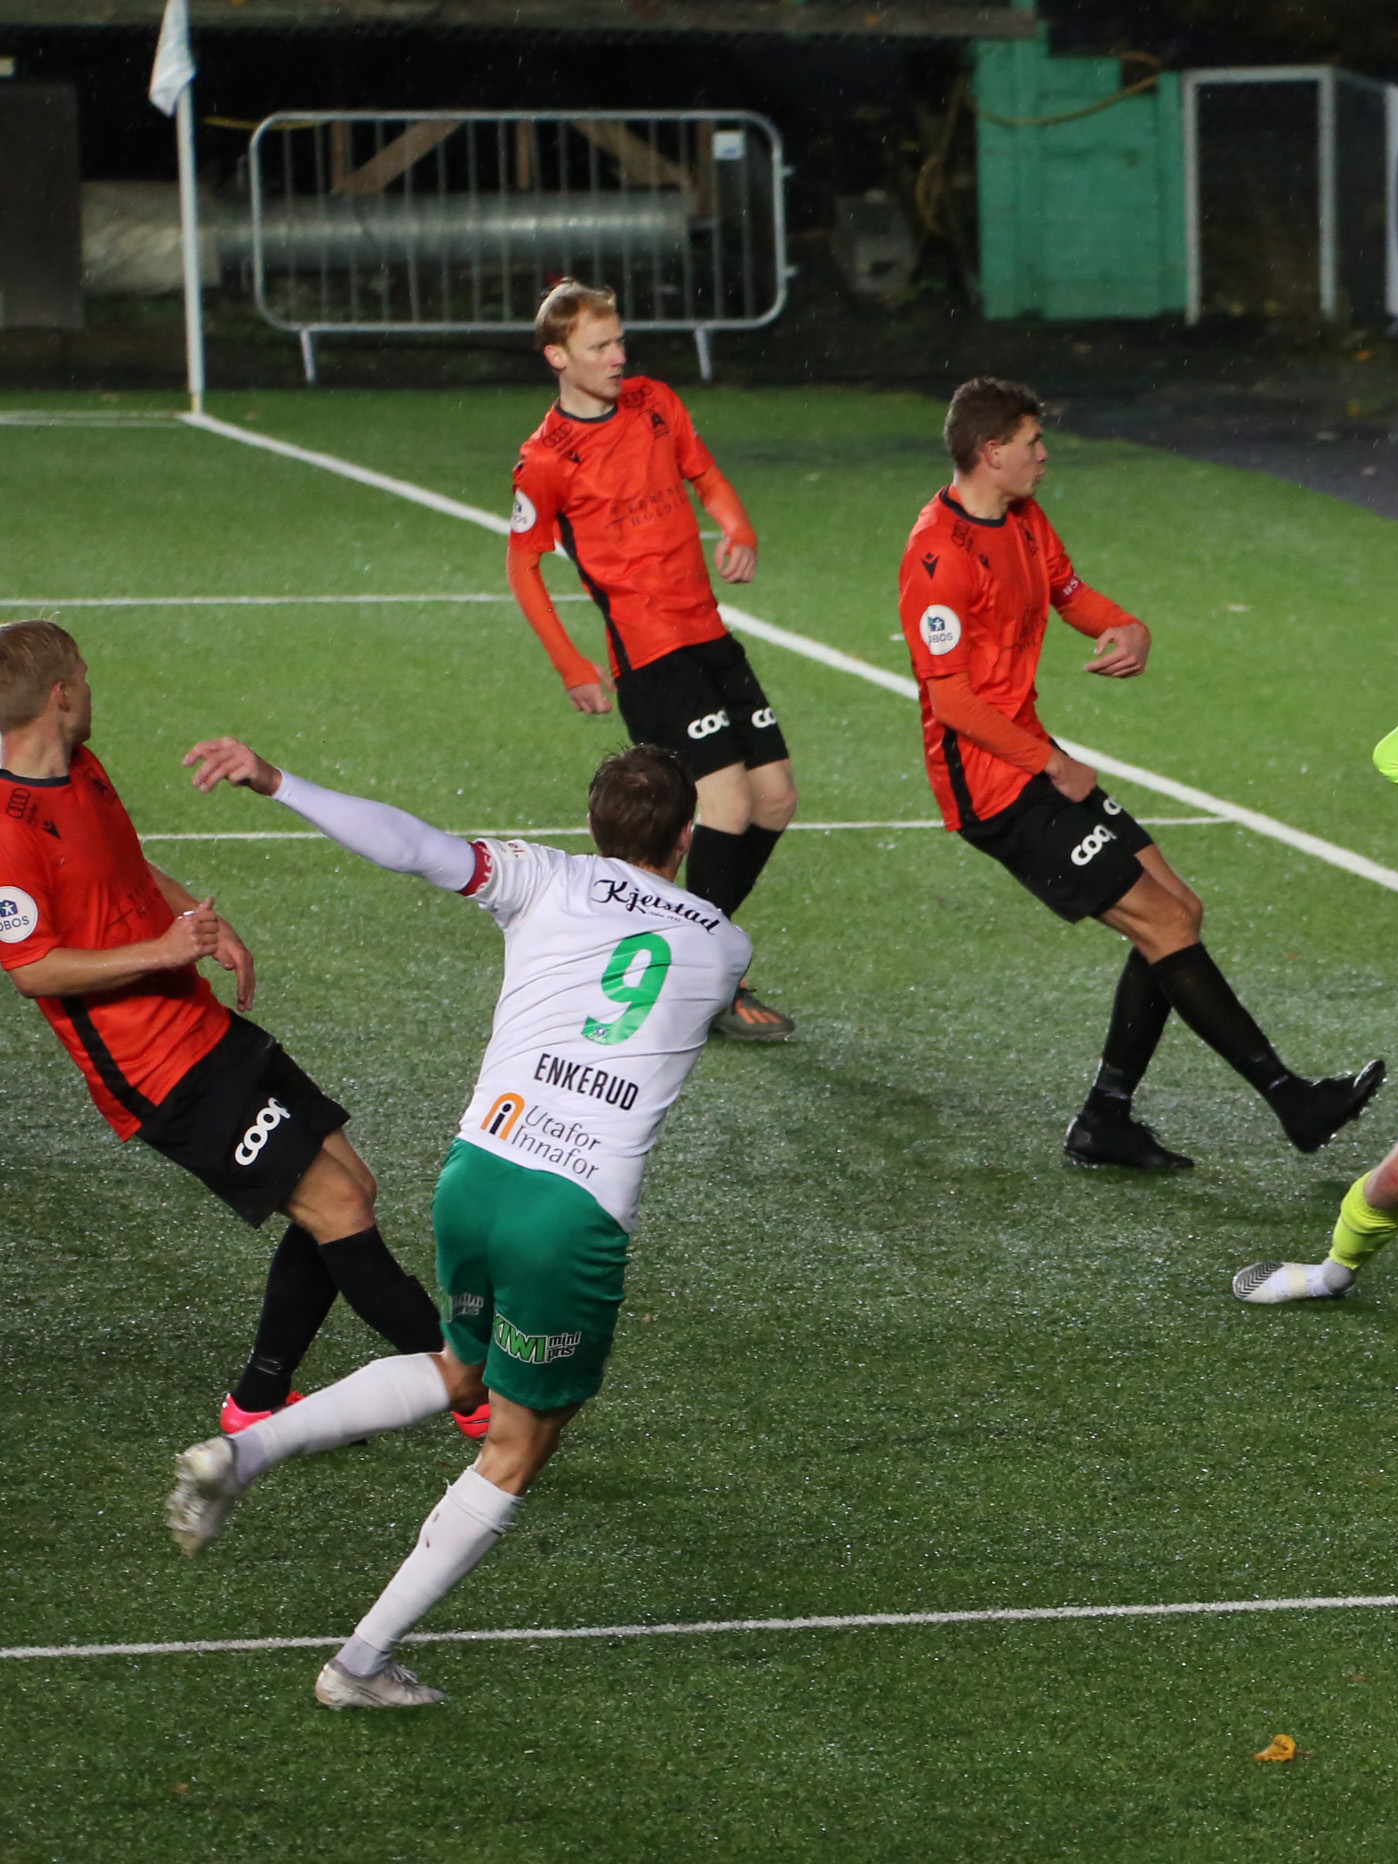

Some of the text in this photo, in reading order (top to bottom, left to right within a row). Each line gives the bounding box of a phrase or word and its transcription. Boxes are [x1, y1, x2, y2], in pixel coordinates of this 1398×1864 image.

[687, 708, 731, 739] coo
[1071, 824, 1117, 866] coo
[580, 932, 672, 1045] 9
[534, 1053, 639, 1111] ENKERUD
[525, 1105, 602, 1151] Utafor
[511, 1125, 599, 1180] Innafor
[546, 1346, 575, 1363] pris
[548, 1331, 581, 1349] mini
